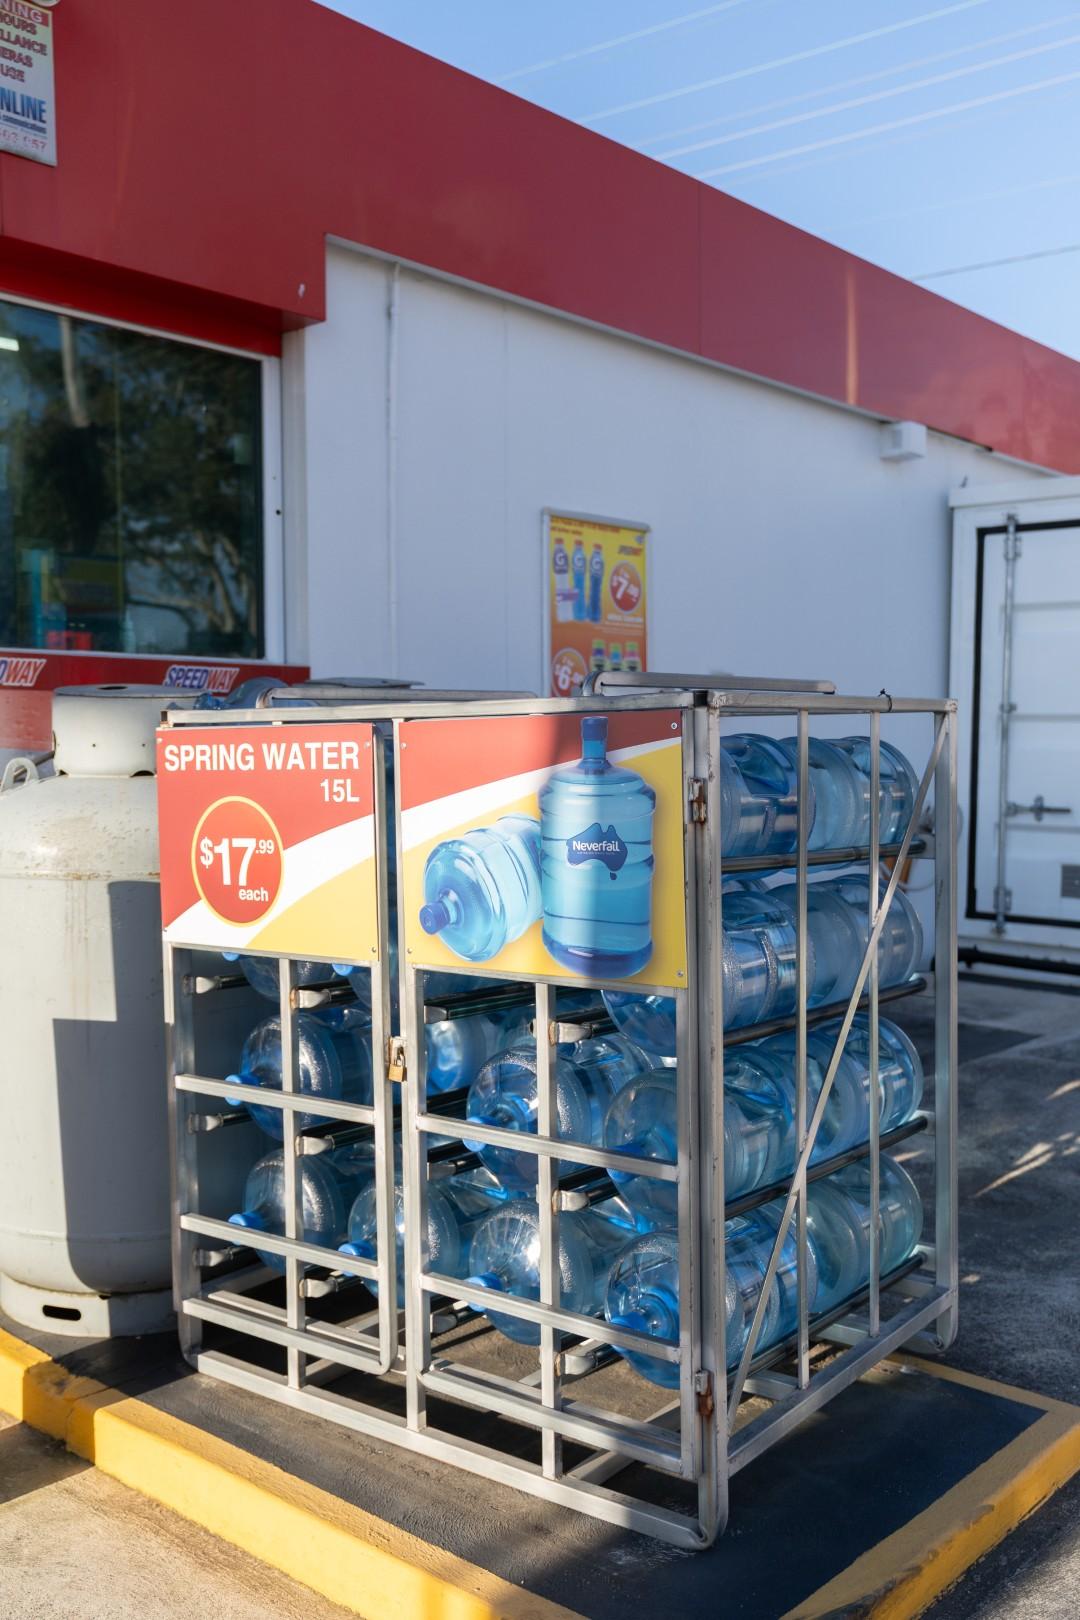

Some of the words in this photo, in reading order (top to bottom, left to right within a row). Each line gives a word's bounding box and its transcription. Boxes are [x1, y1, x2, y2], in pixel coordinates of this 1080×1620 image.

[164, 667, 239, 690] SPEEDWAY
[164, 743, 255, 772] SPRING
[261, 741, 360, 771] WATER
[319, 778, 360, 802] 15L
[572, 840, 620, 852] Neverfail
[238, 887, 269, 902] each
